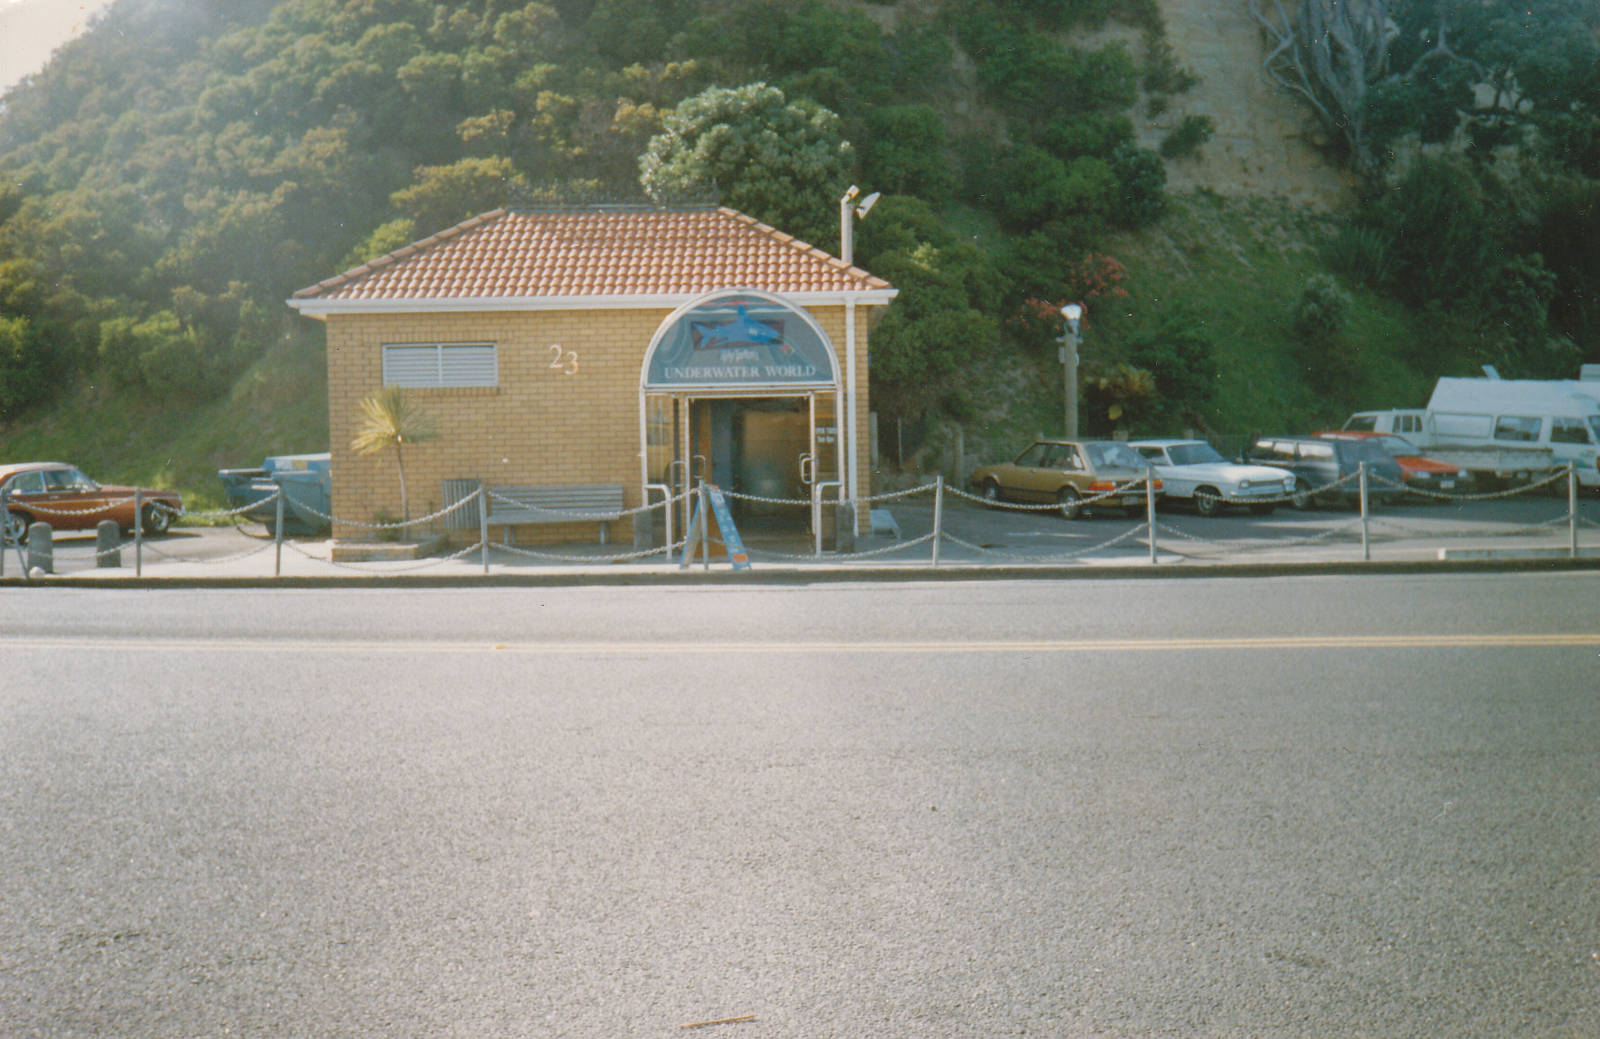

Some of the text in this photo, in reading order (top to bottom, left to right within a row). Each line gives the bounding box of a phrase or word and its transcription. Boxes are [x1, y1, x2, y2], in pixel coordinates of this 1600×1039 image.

[549, 343, 579, 376] 23
[664, 365, 817, 379] UNDERWATER WORLD
